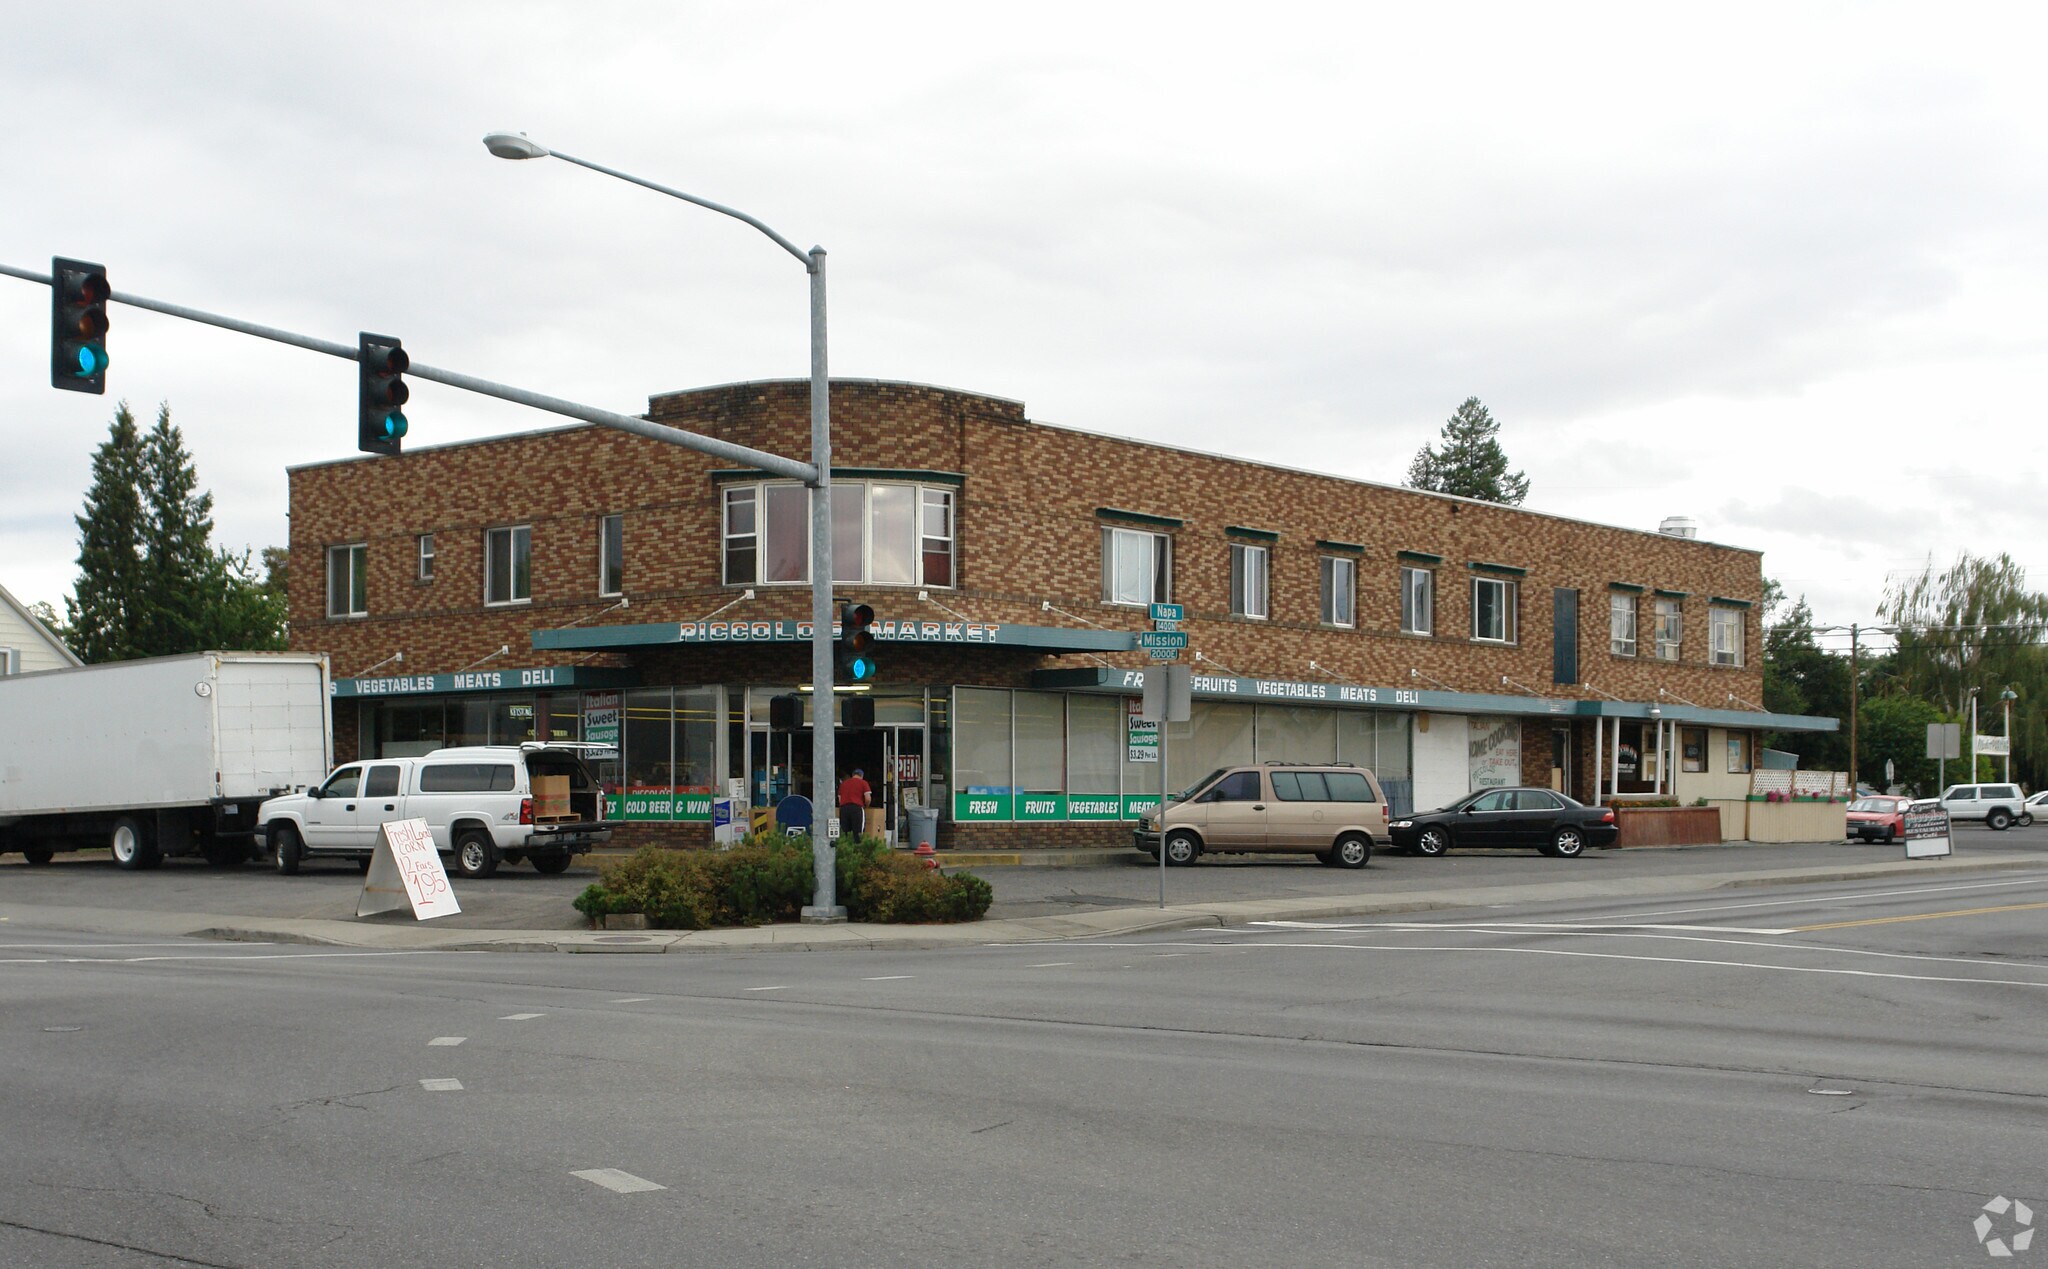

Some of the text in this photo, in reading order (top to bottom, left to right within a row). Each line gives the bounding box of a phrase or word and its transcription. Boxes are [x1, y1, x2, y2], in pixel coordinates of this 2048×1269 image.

[1157, 605, 1177, 619] Napa
[869, 621, 1000, 643] MARKET
[1144, 634, 1183, 646] Mission
[1151, 649, 1176, 658] 2000E
[355, 676, 435, 694] VEGETABLES
[454, 672, 502, 689] MEATS
[522, 669, 554, 685] DELI
[1194, 676, 1237, 693] FRUITS
[1256, 681, 1326, 698] VEGETABLES
[1340, 687, 1377, 701] MEATS
[1395, 691, 1419, 703] DELI
[586, 692, 618, 709] Italian
[587, 710, 617, 726] Sweet
[585, 729, 618, 741] Sausage
[1129, 732, 1158, 745] Sausage
[1130, 750, 1145, 760] $3.29
[1479, 777, 1506, 786] RESTAURANT
[626, 801, 647, 814] COLD
[649, 801, 671, 814] BEER
[676, 802, 683, 814] &
[687, 801, 713, 814] WIN
[969, 801, 998, 814] FRESH
[1025, 801, 1056, 814] FRUITS
[1069, 801, 1119, 814] VEGETABLES
[1906, 826, 1948, 834] RESTAURANT
[399, 840, 426, 855] CORN
[400, 856, 433, 877] 12 Ears
